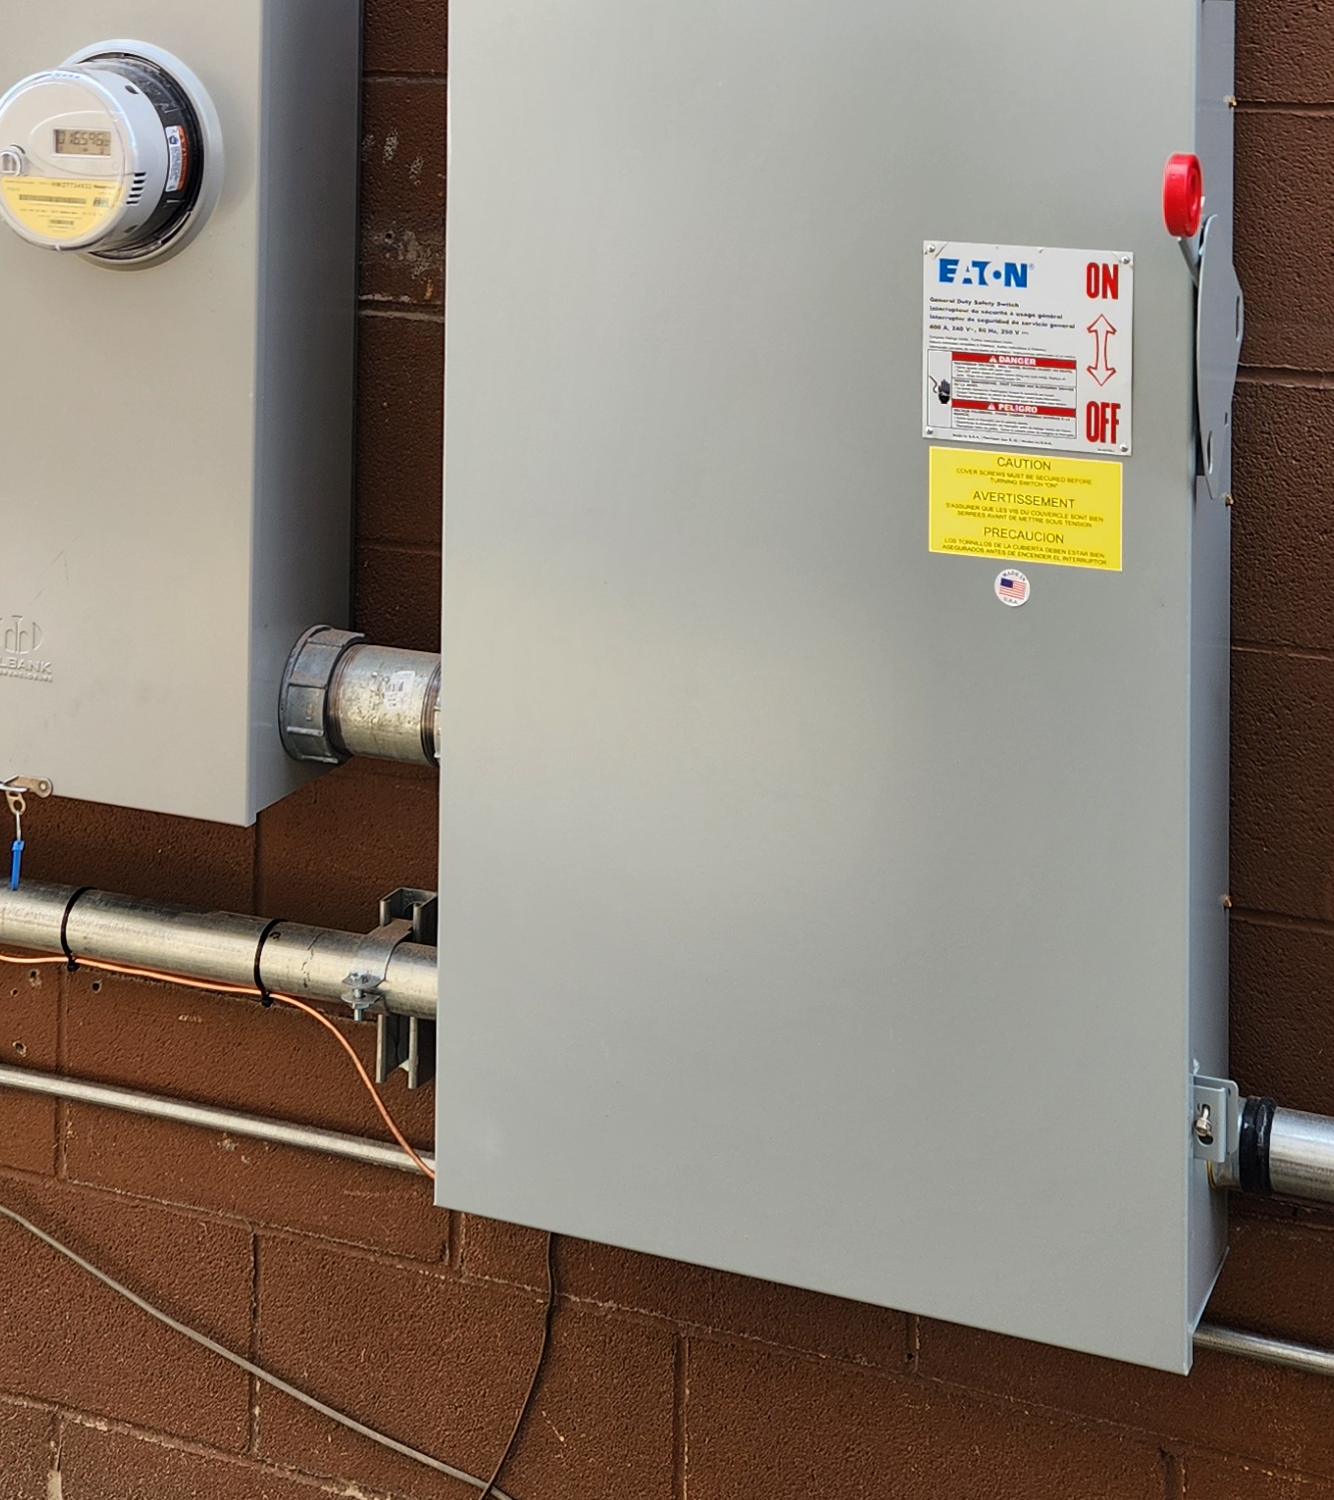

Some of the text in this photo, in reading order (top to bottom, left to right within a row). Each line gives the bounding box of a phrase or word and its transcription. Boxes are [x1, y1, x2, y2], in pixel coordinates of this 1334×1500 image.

[1086, 262, 1119, 300] ON
[999, 356, 1036, 366] DANGER
[998, 404, 1038, 414] PELIGRO
[1086, 401, 1121, 444] OFF
[997, 457, 1051, 471] CAUTION
[990, 477, 1018, 485] TURNING
[1036, 474, 1066, 483] SECURED
[1067, 477, 1092, 485] BEFORE
[973, 491, 1075, 509] AVERTISSEMENT
[1031, 510, 1068, 519] COUVERCLE
[1065, 520, 1092, 528] TENSION
[984, 526, 1064, 544] PRECAUCION
[959, 539, 992, 547] TORNILLOS
[1045, 547, 1066, 555] DEBEN
[1068, 549, 1088, 557] ESTAR
